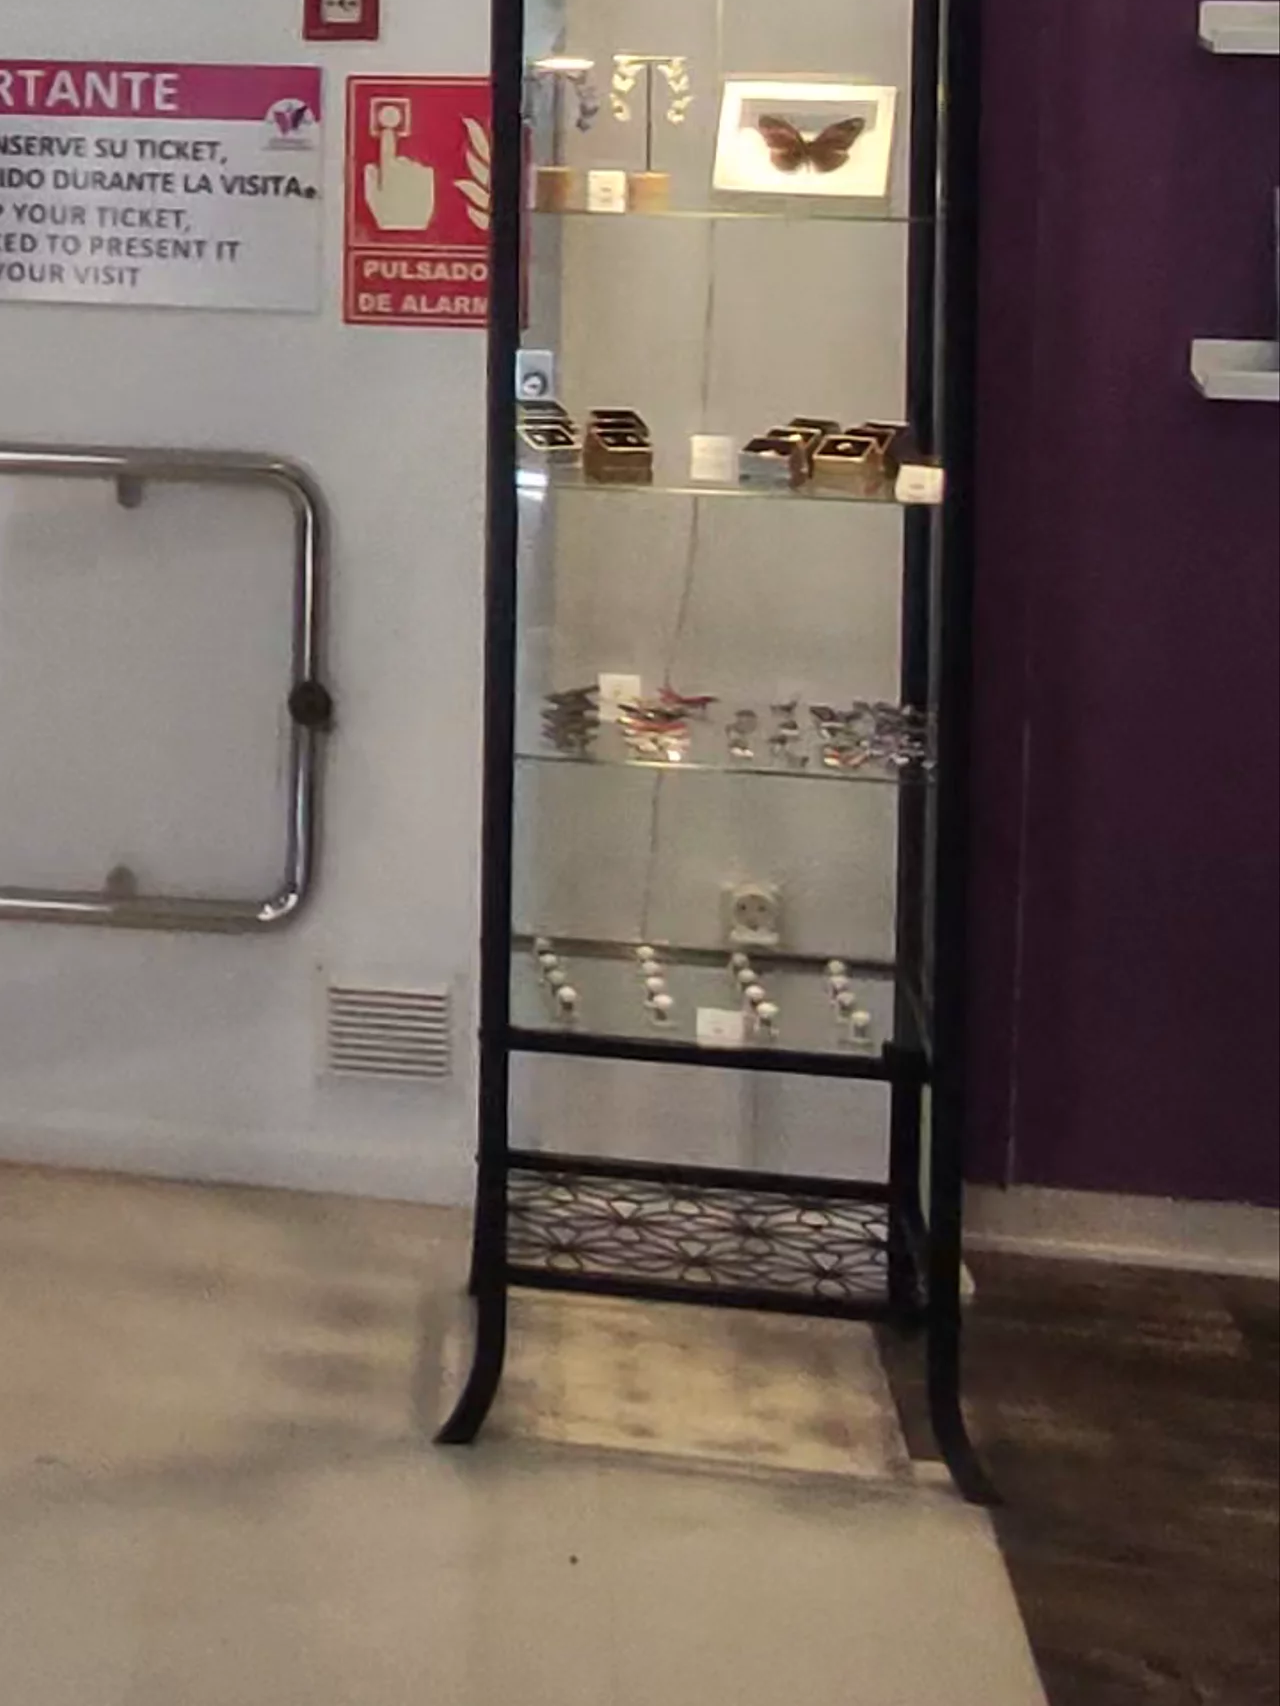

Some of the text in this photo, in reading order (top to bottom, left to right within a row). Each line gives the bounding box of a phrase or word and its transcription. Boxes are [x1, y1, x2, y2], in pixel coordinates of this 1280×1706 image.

[94, 137, 129, 160] SU
[134, 138, 228, 166] TICKET,
[52, 168, 176, 194] DURANTE
[183, 173, 214, 195] LA
[11, 202, 87, 226] YOUR
[96, 205, 191, 234] TICKET,
[44, 233, 83, 257] TO
[89, 235, 208, 260] PRESENT
[215, 240, 242, 263] IT
[73, 264, 142, 288] VISIT
[363, 260, 488, 281] PULSADO
[359, 292, 488, 315] DE ALARM
